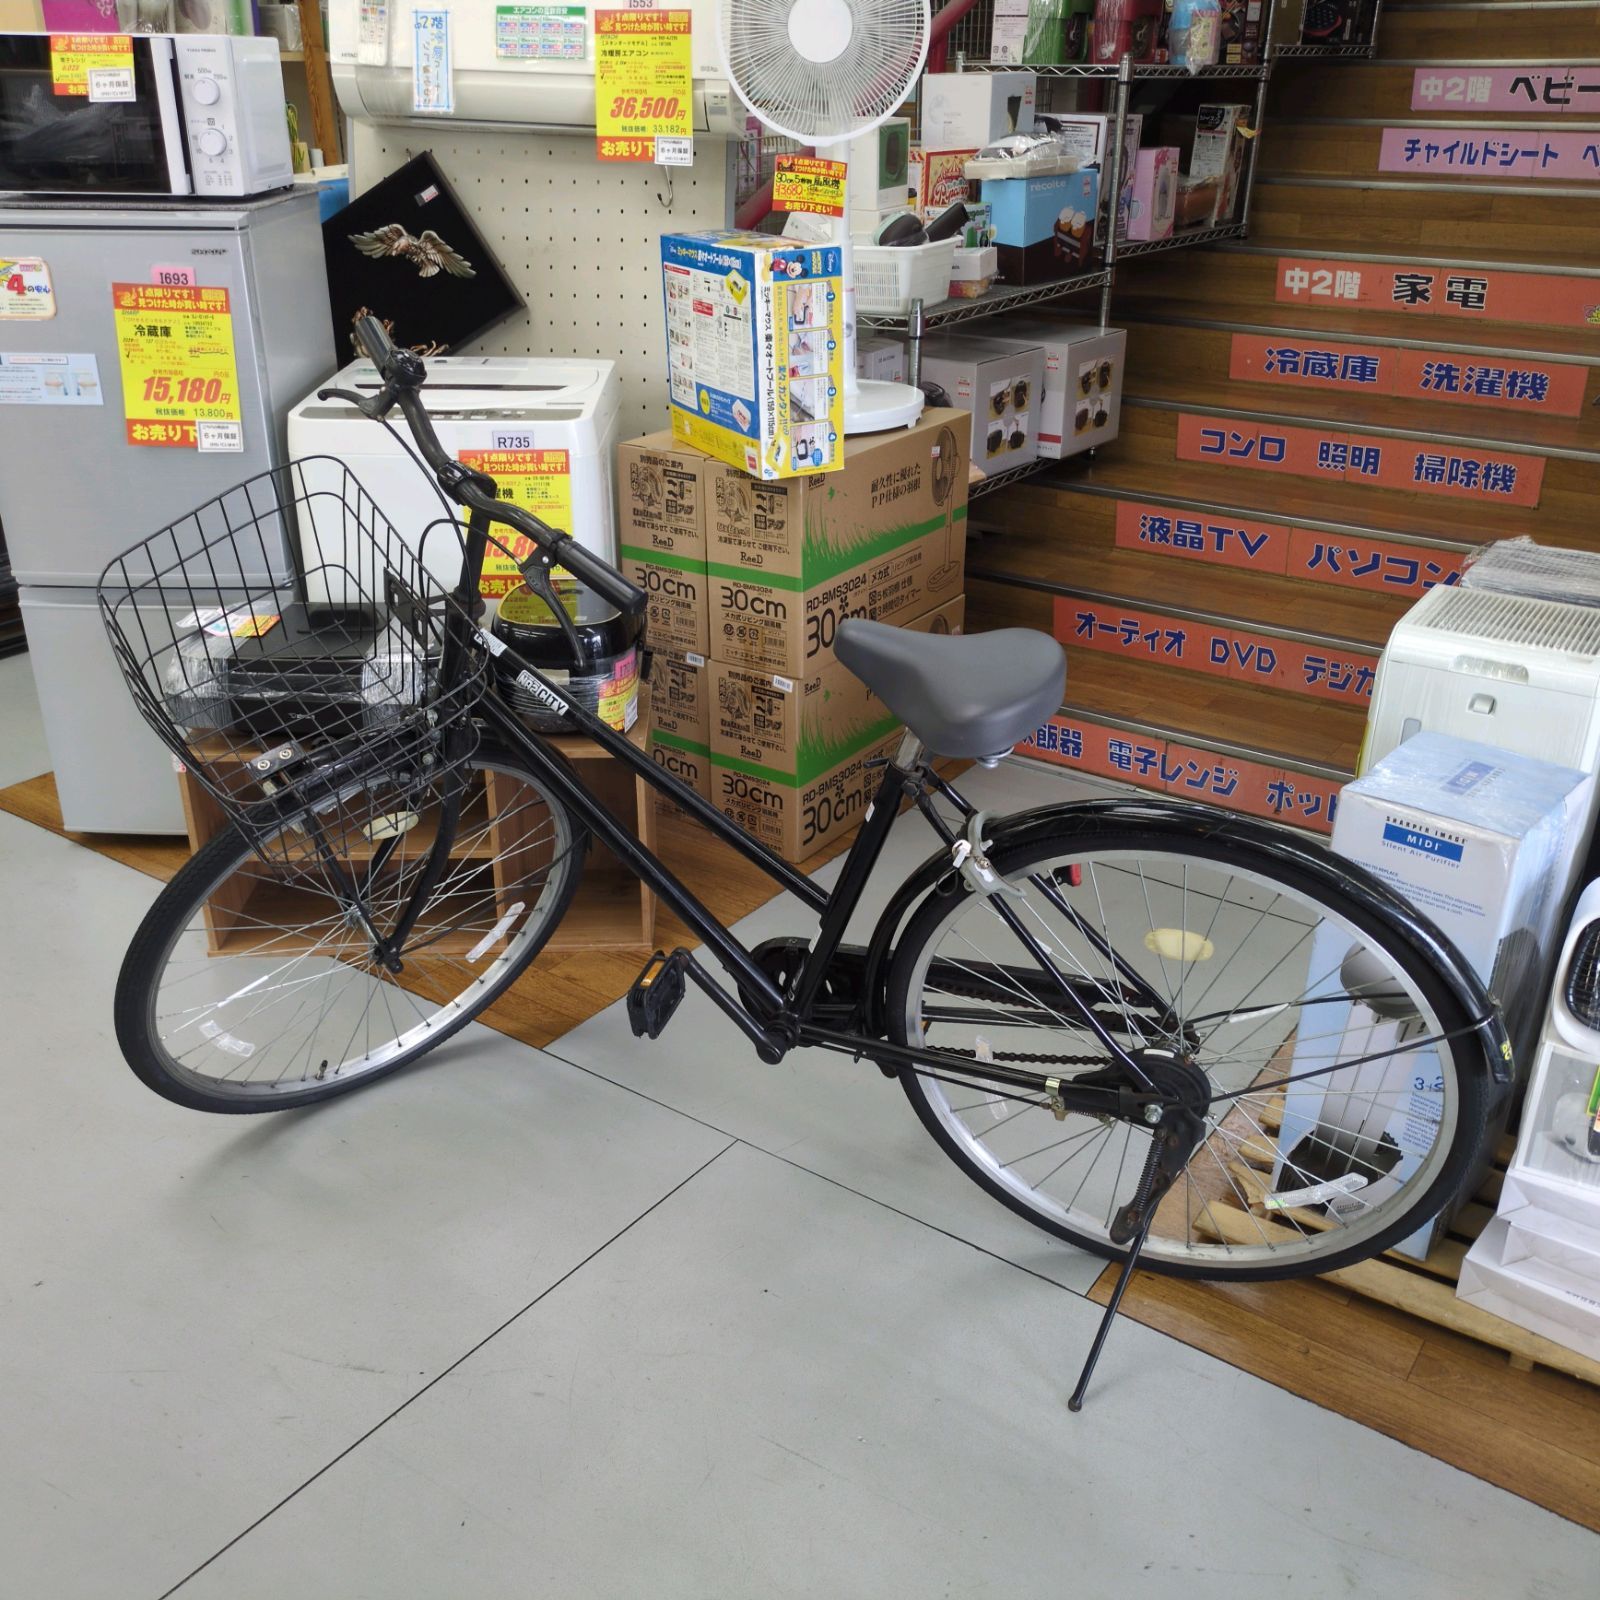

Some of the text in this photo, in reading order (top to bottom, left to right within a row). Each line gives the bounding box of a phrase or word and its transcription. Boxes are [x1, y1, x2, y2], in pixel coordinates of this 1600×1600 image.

[601, 49, 649, 58] 冷暖房エアコン
[1420, 75, 1493, 103] 中2階
[601, 140, 656, 158] お売り下
[1404, 138, 1559, 168] チャイルドシート
[1030, 179, 1066, 192] récolte
[784, 201, 833, 215] お売り下さい!
[1284, 267, 1362, 300] 中2階
[763, 286, 772, 331] ミッキーマウス
[134, 324, 172, 338] 冷蔵庫
[1264, 348, 1550, 403] 冷蔵庫 洗濯機
[155, 407, 185, 416] 税抜価格
[132, 424, 198, 443] お売り下
[498, 437, 530, 448] R735
[482, 462, 567, 473] 見つけた時が買い時です!
[483, 452, 538, 463] 1点限りです!
[1200, 429, 1517, 494] コンロ 照明 掃除機
[808, 473, 826, 489] ReeD
[871, 463, 921, 494] 耐久性に優れた
[652, 534, 674, 548] ReeD
[1139, 513, 1461, 589] 液晶TV パソコン
[495, 564, 520, 572] 税抜価
[741, 551, 763, 565] ReeD
[635, 567, 696, 601] 30cm
[871, 566, 890, 584] メカ式
[720, 585, 787, 620] 30cm
[806, 573, 867, 614] RD-BMS3024
[806, 605, 867, 658] 30
[1075, 611, 1376, 698] オーディオ DVD デジカ
[804, 677, 821, 695] ReeD
[657, 717, 678, 731] ReeD
[653, 748, 698, 779] 0cm
[740, 745, 762, 760] ReeD
[1022, 722, 1083, 760] 飯器
[1107, 737, 1239, 797] 電子レンジ
[722, 774, 784, 810] 30cm
[802, 760, 863, 806] RD-BMS3024
[803, 790, 863, 846] 30cm
[1386, 816, 1466, 845] SHARPER IMAGE
[1381, 840, 1460, 871] Silent Air Purifier
[1406, 834, 1439, 851] MIDI
